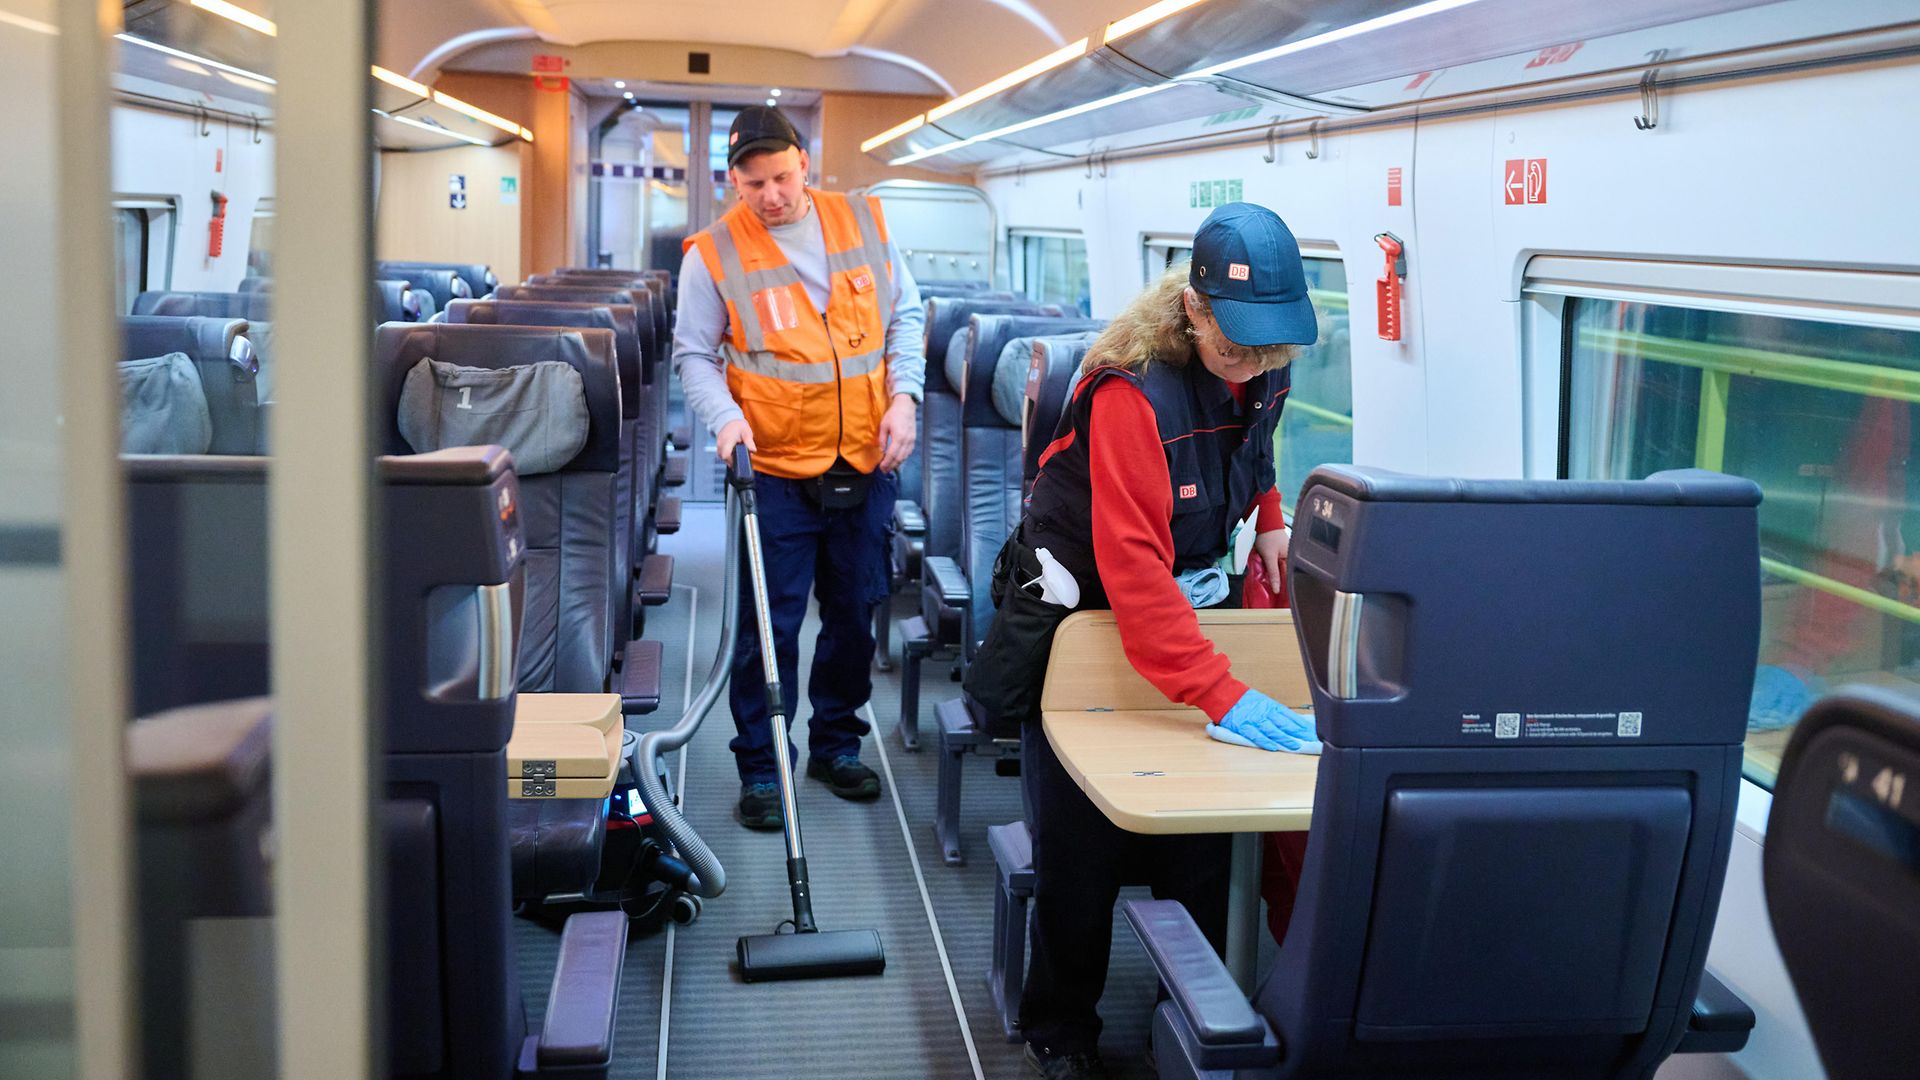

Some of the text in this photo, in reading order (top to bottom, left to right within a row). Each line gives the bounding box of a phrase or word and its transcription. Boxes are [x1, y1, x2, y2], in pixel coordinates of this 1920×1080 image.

[1231, 266, 1247, 278] DB
[456, 386, 473, 410] 1
[1181, 486, 1195, 497] DB
[1321, 500, 1334, 519] 34
[1872, 767, 1906, 810] 41
